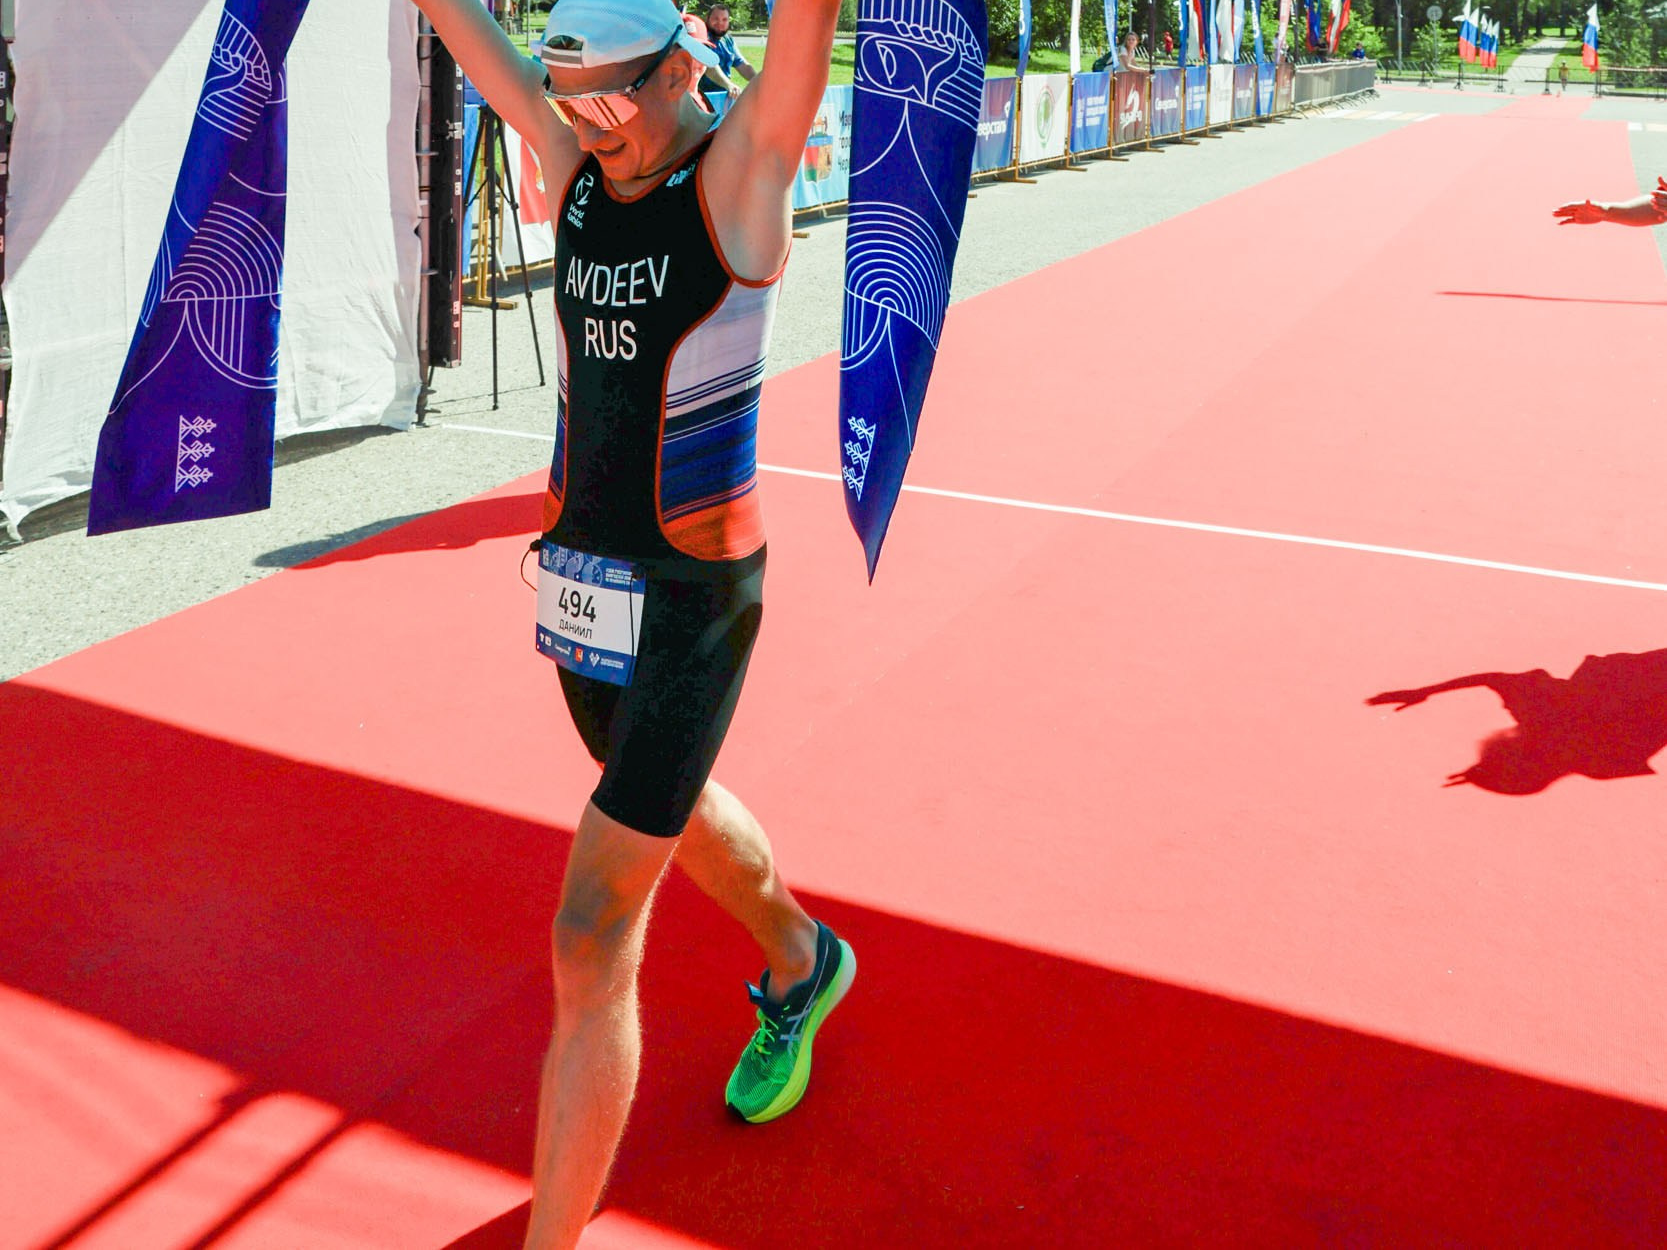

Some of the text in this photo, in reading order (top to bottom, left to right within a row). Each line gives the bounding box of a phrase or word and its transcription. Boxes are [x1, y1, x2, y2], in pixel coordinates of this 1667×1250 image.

[565, 255, 670, 307] AVDEEV
[585, 317, 637, 361] RUS
[558, 587, 597, 623] 494
[558, 618, 593, 639] ДАНИИЛ
